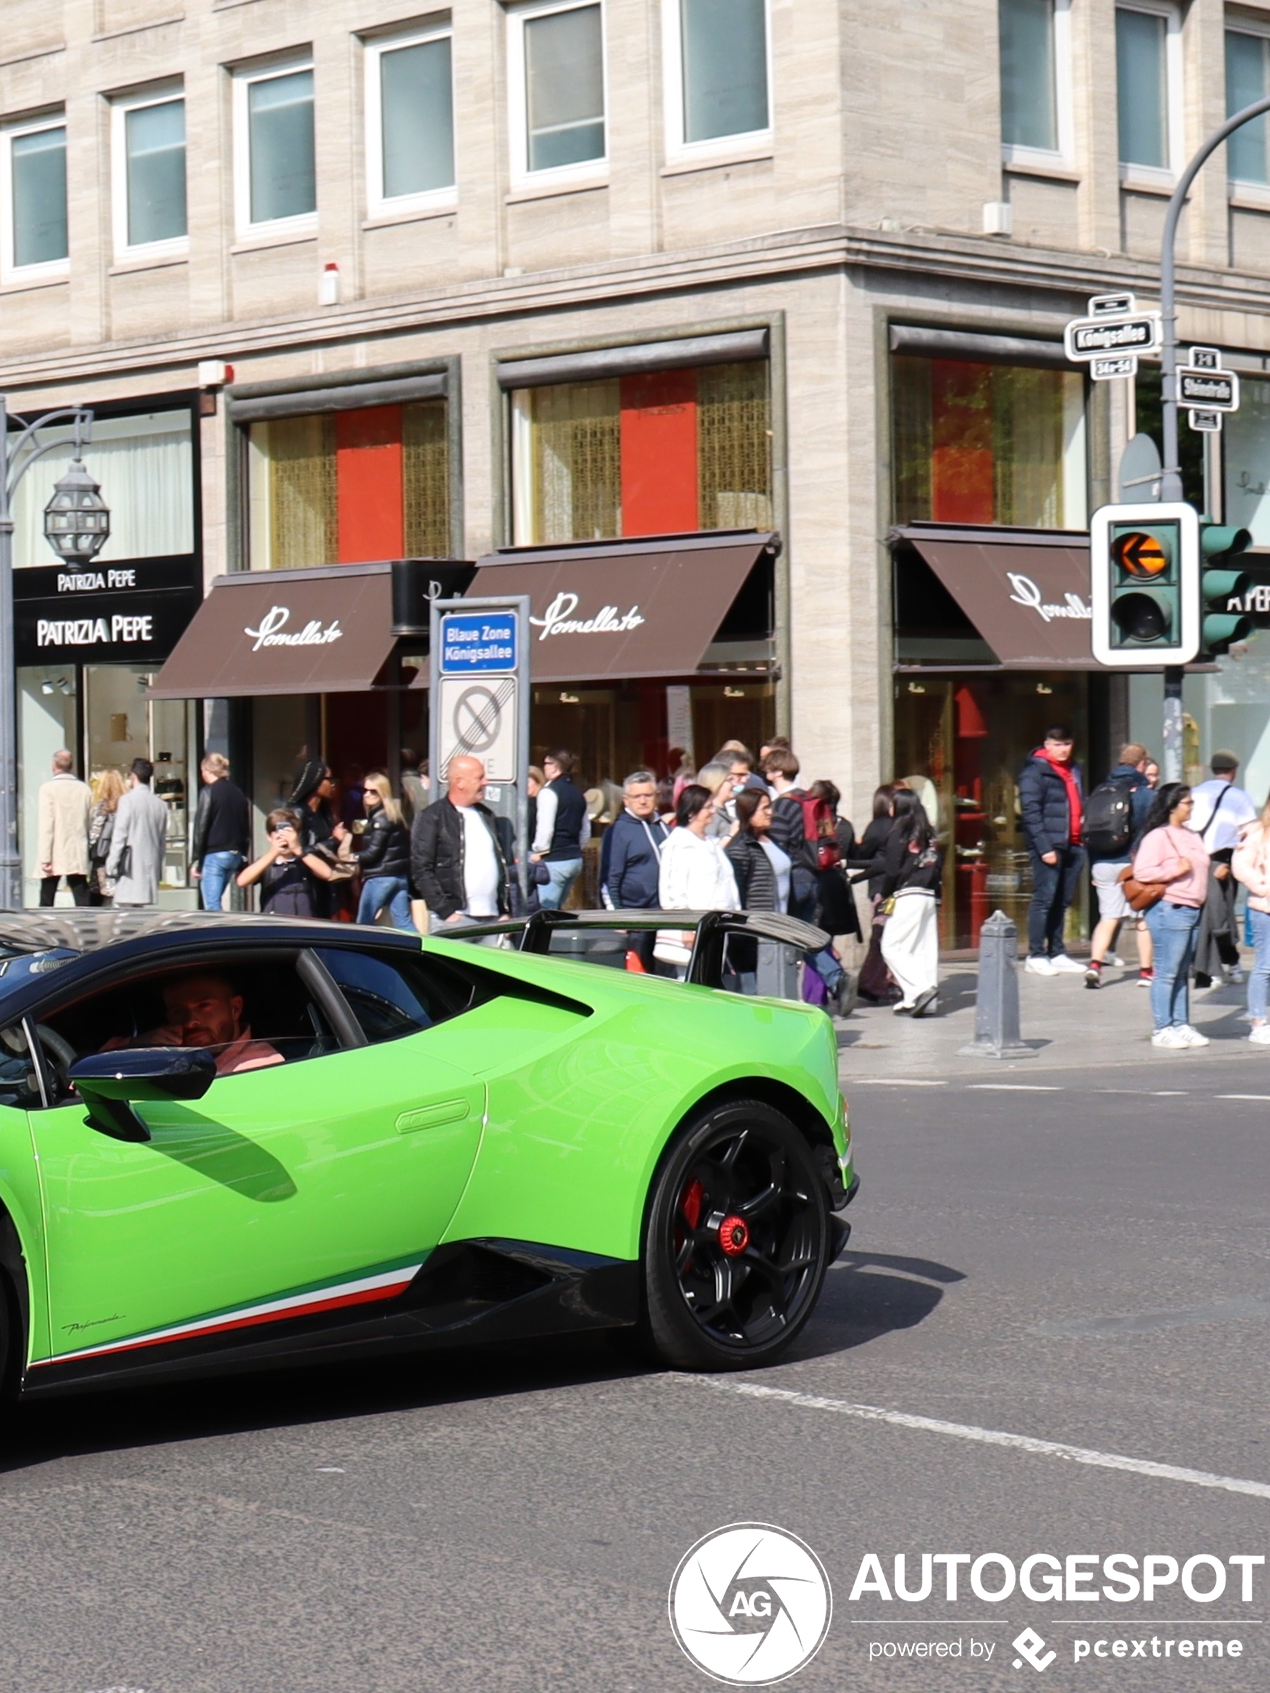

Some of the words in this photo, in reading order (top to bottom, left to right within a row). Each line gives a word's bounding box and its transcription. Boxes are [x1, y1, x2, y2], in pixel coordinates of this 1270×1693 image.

[1077, 325, 1146, 349] Königsallee
[57, 573, 106, 592] PATRIZIA
[107, 569, 136, 588] PEPE
[244, 605, 343, 651] Pomellato
[529, 592, 645, 641] Pomellato
[37, 619, 110, 647] PATRIZIA
[111, 615, 152, 642] PEPE
[446, 627, 479, 642] Blaue
[481, 625, 511, 641] Zone
[445, 644, 512, 663] Königsallee
